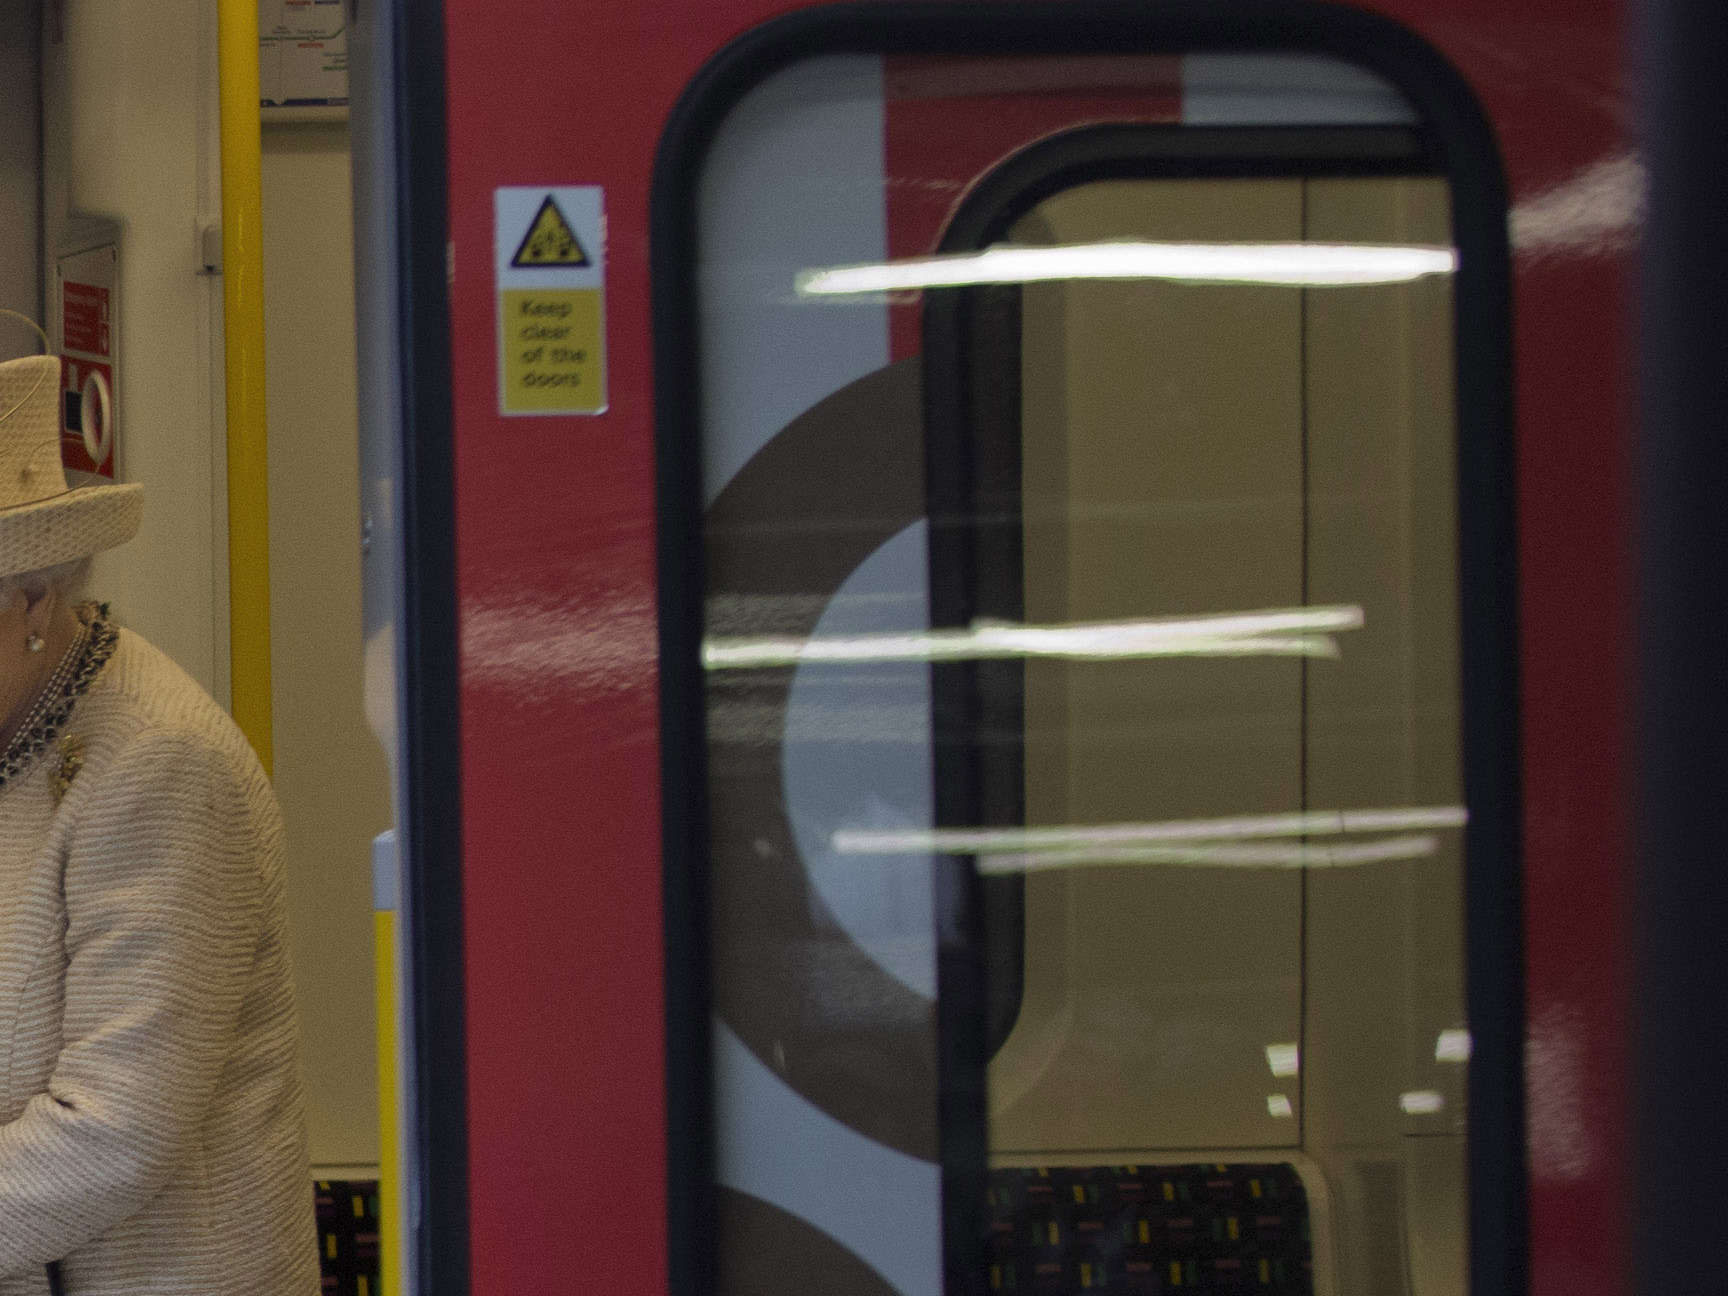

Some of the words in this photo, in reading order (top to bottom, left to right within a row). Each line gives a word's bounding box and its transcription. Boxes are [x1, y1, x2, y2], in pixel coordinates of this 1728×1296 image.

[520, 300, 572, 319] Keep
[520, 322, 571, 339] clear
[522, 346, 545, 363] of
[551, 346, 586, 363] the
[523, 370, 582, 388] doors
